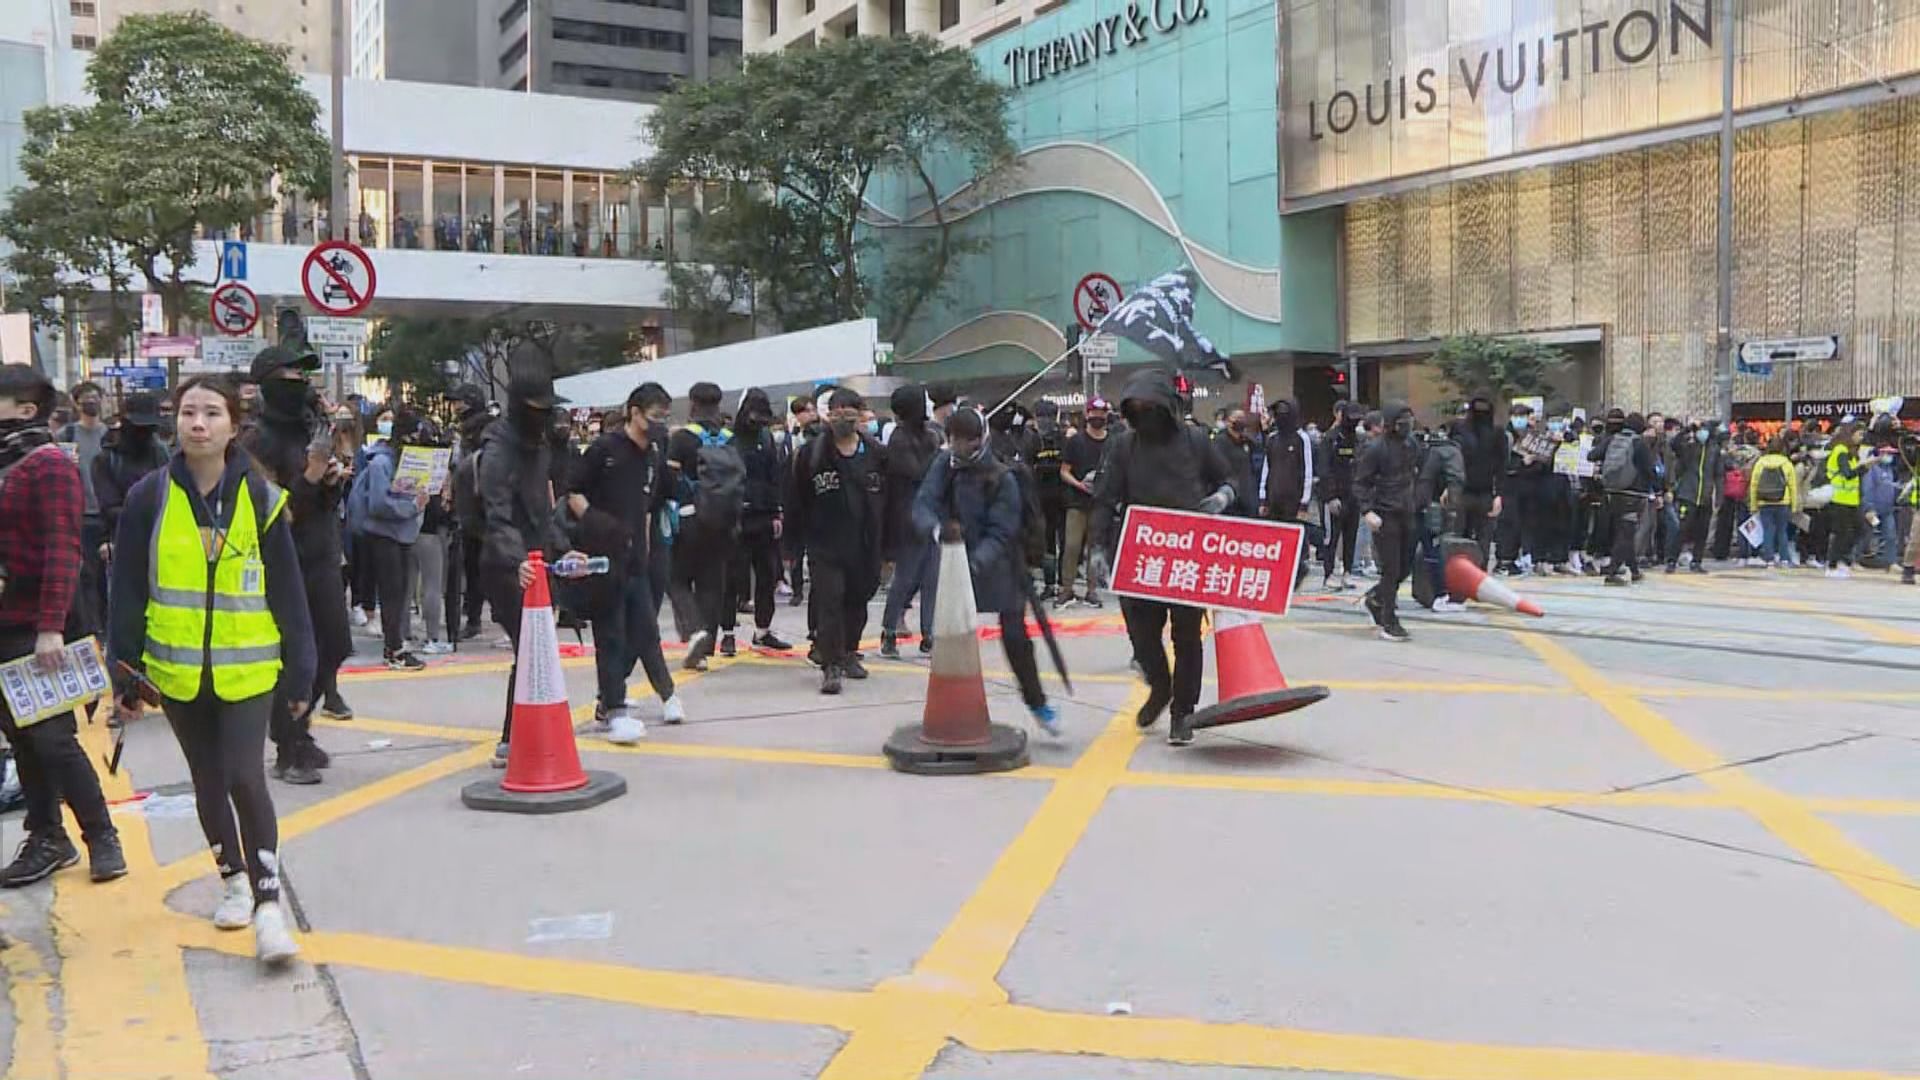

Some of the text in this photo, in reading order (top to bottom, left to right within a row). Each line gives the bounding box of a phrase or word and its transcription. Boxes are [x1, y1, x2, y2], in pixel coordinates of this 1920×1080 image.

[1004, 14, 1121, 89] TIFFANY
[1309, 2, 1713, 141] LOUIS VUITTON
[1797, 402, 1870, 416] LOUIS VUITT
[1135, 524, 1282, 561] Road Closed
